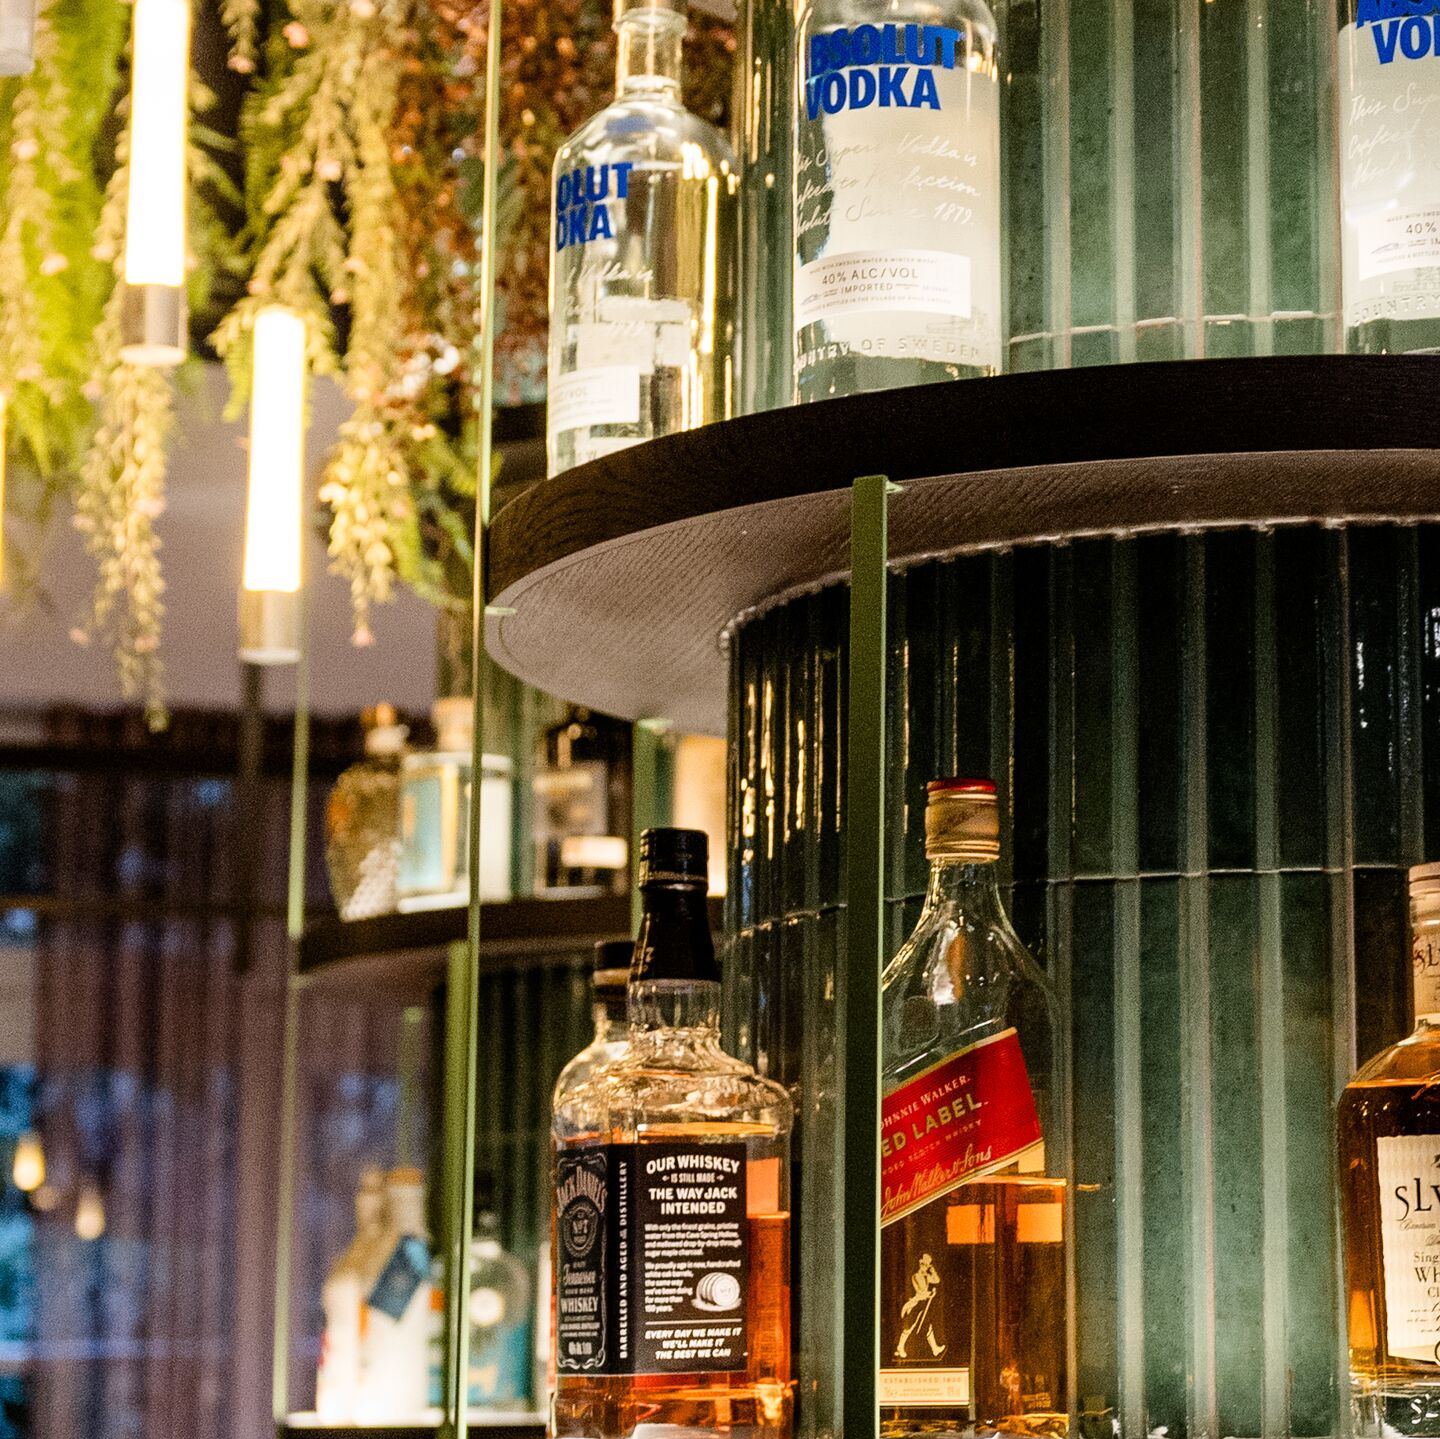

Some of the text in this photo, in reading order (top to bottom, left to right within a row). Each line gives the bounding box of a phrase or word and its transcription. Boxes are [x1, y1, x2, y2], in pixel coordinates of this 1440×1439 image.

[806, 67, 942, 122] VODKA
[1405, 222, 1437, 235] 40%
[821, 267, 919, 285] 40% ALC/VOL
[841, 282, 893, 295] IMPORTED
[945, 1119, 982, 1141] WHISKY
[881, 1132, 907, 1158] ED
[961, 1143, 993, 1172] Sons
[646, 1155, 740, 1175] OUR WHISKEY
[671, 1173, 716, 1183] IS STILL MADE
[648, 1187, 738, 1200] THE WAY JACK
[660, 1202, 726, 1215] INTENDED
[619, 1161, 628, 1359] BARRELED AND AGED DISTILLERY
[560, 1297, 599, 1312] WHISKEY
[645, 1327, 742, 1340] EVERY DAY WE MAKE IT
[662, 1338, 725, 1349] WE'LL MAKE IT
[655, 1348, 731, 1360] THE BEST WE CAN
